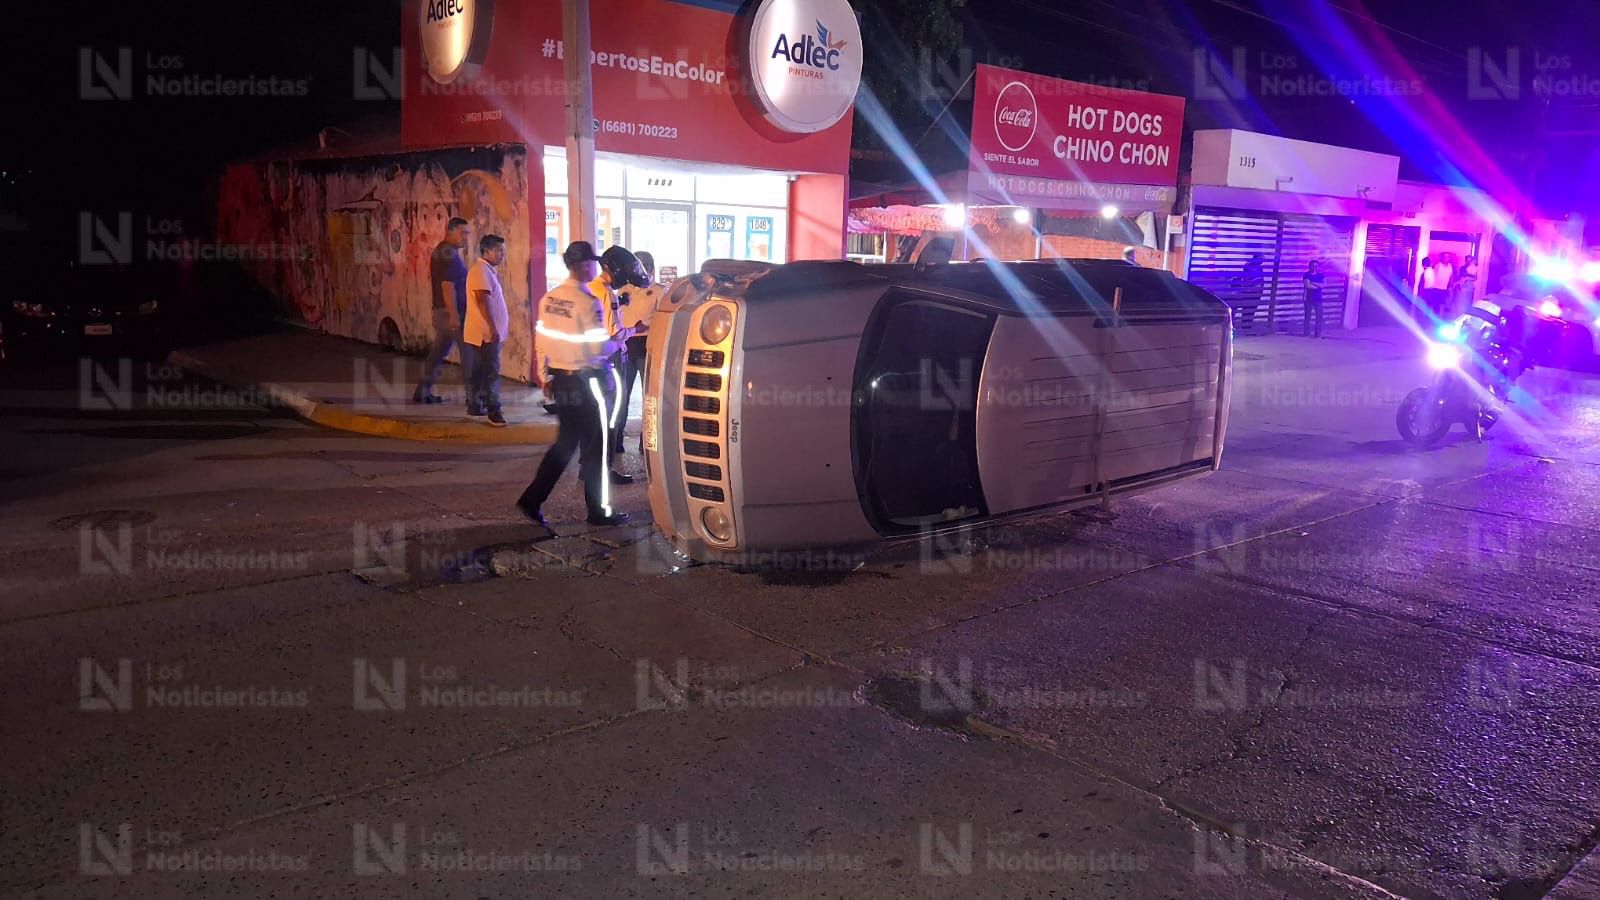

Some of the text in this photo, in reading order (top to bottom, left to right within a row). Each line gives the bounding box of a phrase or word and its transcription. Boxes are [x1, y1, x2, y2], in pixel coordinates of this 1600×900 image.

[771, 33, 840, 71] Adtec
[788, 67, 824, 80] PINTURAS
[602, 119, 678, 140] (6681) 700223
[1067, 104, 1162, 136] HOT DOGS
[984, 152, 1040, 168] SIENTE EL SABOR
[1053, 135, 1170, 167] CHINO CHON
[1239, 156, 1256, 168] 1315
[988, 175, 1014, 191] HOT
[1019, 181, 1053, 194] DOGS
